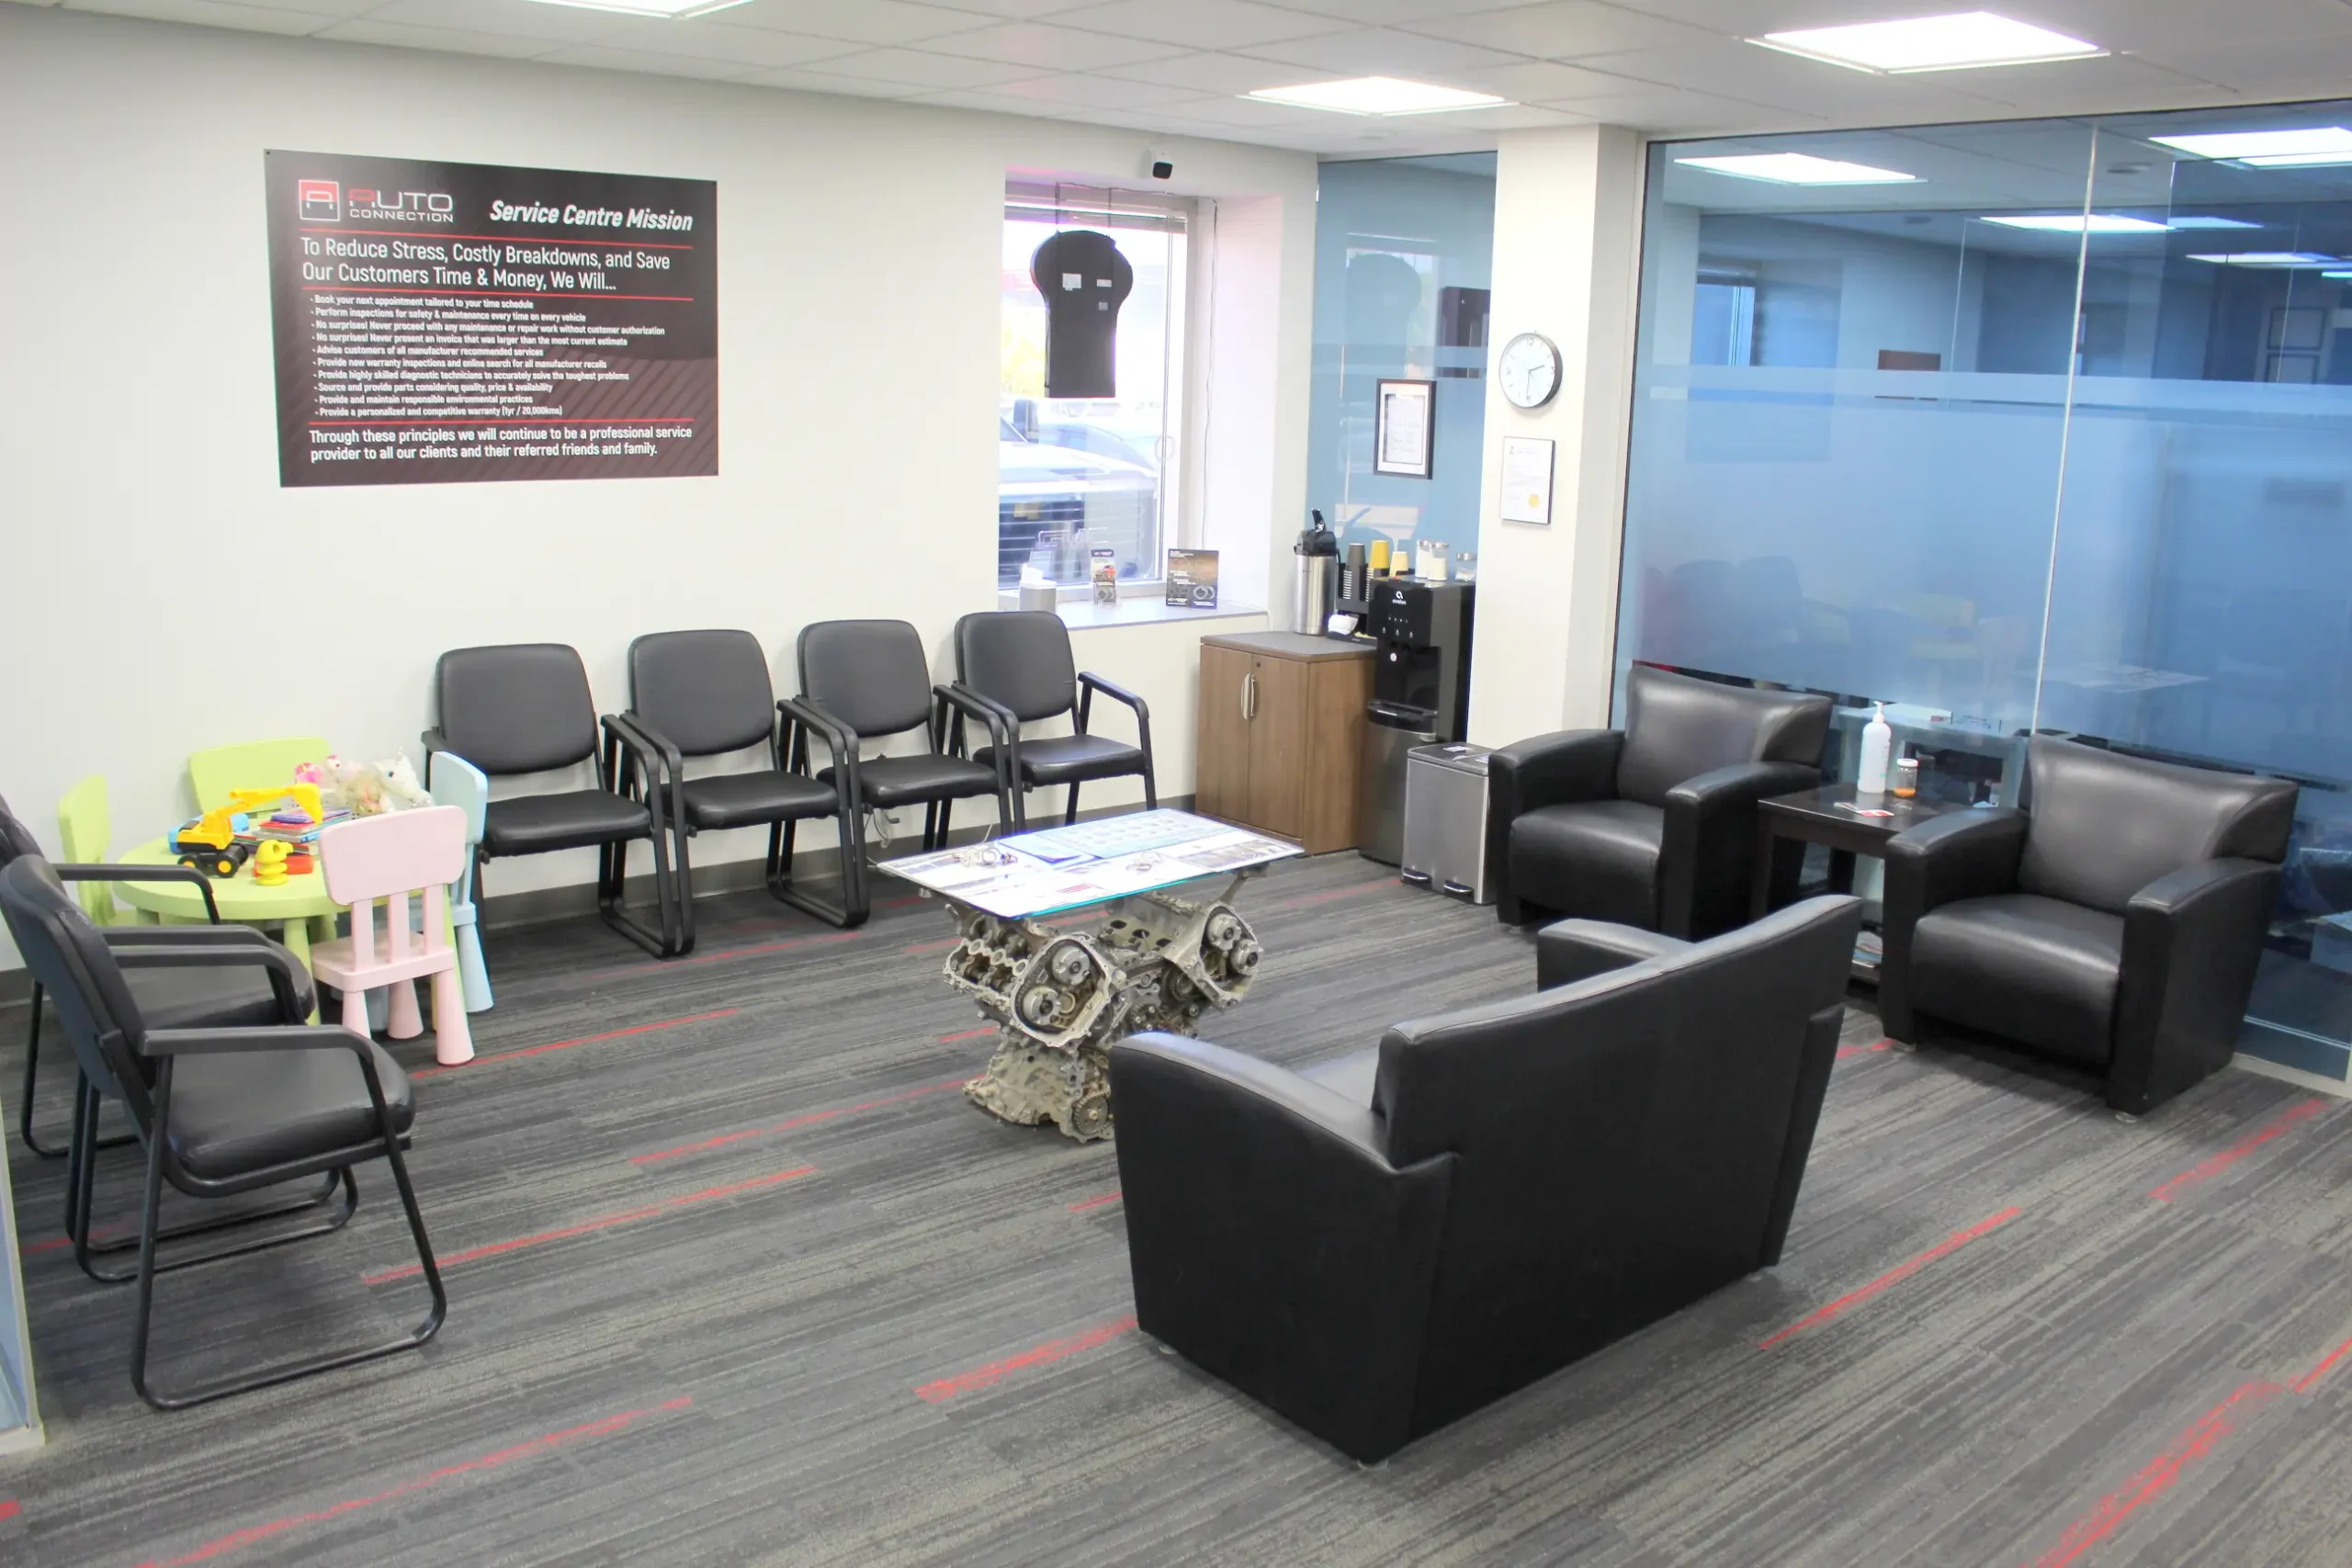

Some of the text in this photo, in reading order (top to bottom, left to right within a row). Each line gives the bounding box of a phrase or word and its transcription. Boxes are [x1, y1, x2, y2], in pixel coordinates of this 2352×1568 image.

[348, 188, 454, 212] AUTO
[349, 209, 454, 223] CONNECTION
[489, 200, 694, 231] Service Centre Mission
[301, 237, 671, 269] To Reduce Stress, Costly Breakdowns, and Save
[302, 262, 616, 291] Our Customers Time & Money, We Will...
[314, 295, 533, 310] Book your next appointment tailored to your time schedule
[316, 309, 347, 317] Perform
[349, 310, 393, 320] inspections
[395, 310, 406, 319] for
[408, 310, 432, 321] safety
[434, 310, 439, 319] &
[441, 310, 489, 320] maintenance
[491, 313, 511, 322] every
[512, 312, 528, 321] time
[540, 314, 560, 323] every
[561, 313, 586, 321] vehicle
[316, 321, 326, 329] No
[369, 321, 391, 330] Never
[393, 321, 424, 333] proceed
[425, 322, 443, 331] with
[444, 324, 458, 333] any
[458, 322, 506, 333] maintenance
[516, 323, 538, 334] repair
[539, 324, 558, 333] work
[559, 324, 585, 333] without
[586, 325, 619, 334] customer
[620, 325, 665, 335] authorization
[316, 333, 327, 342] No
[369, 334, 391, 343] Never
[393, 334, 423, 344] present
[435, 335, 462, 344] invoice
[463, 335, 479, 344] that
[496, 336, 518, 345] larger
[520, 336, 537, 344] than
[537, 336, 549, 344] the
[550, 336, 569, 345] most
[570, 337, 596, 345] current
[597, 337, 628, 345] estimate
[317, 345, 544, 356] Advise customers of all manufacturer recommended services
[318, 358, 346, 367] Provide
[366, 358, 401, 368] warranty
[402, 359, 446, 369] inspections
[447, 359, 461, 367] and
[462, 359, 484, 367] online
[486, 359, 511, 367] search
[512, 359, 523, 368] for
[524, 359, 533, 368] all
[535, 360, 582, 368] manufacturer
[583, 360, 606, 368] recalls
[318, 371, 629, 382] Provide highly skilled diagnostic technicians to accurately solve the toughest problems
[319, 383, 345, 391] Source
[347, 383, 362, 391] and
[363, 383, 392, 393] provide
[393, 383, 413, 393] parts
[415, 383, 458, 393] considering
[487, 384, 506, 393] price
[514, 384, 553, 393] availability
[320, 395, 533, 405] Provide and maintain responsible environmental practices
[320, 408, 348, 416] Provide
[356, 407, 405, 417] personalized
[407, 407, 421, 415] and
[422, 407, 466, 417] competitive
[467, 407, 500, 417] warranty
[309, 426, 692, 445] Through these principles we will continue to be a professional service
[311, 443, 657, 463] provider to all our clients and their referred friends and family.
